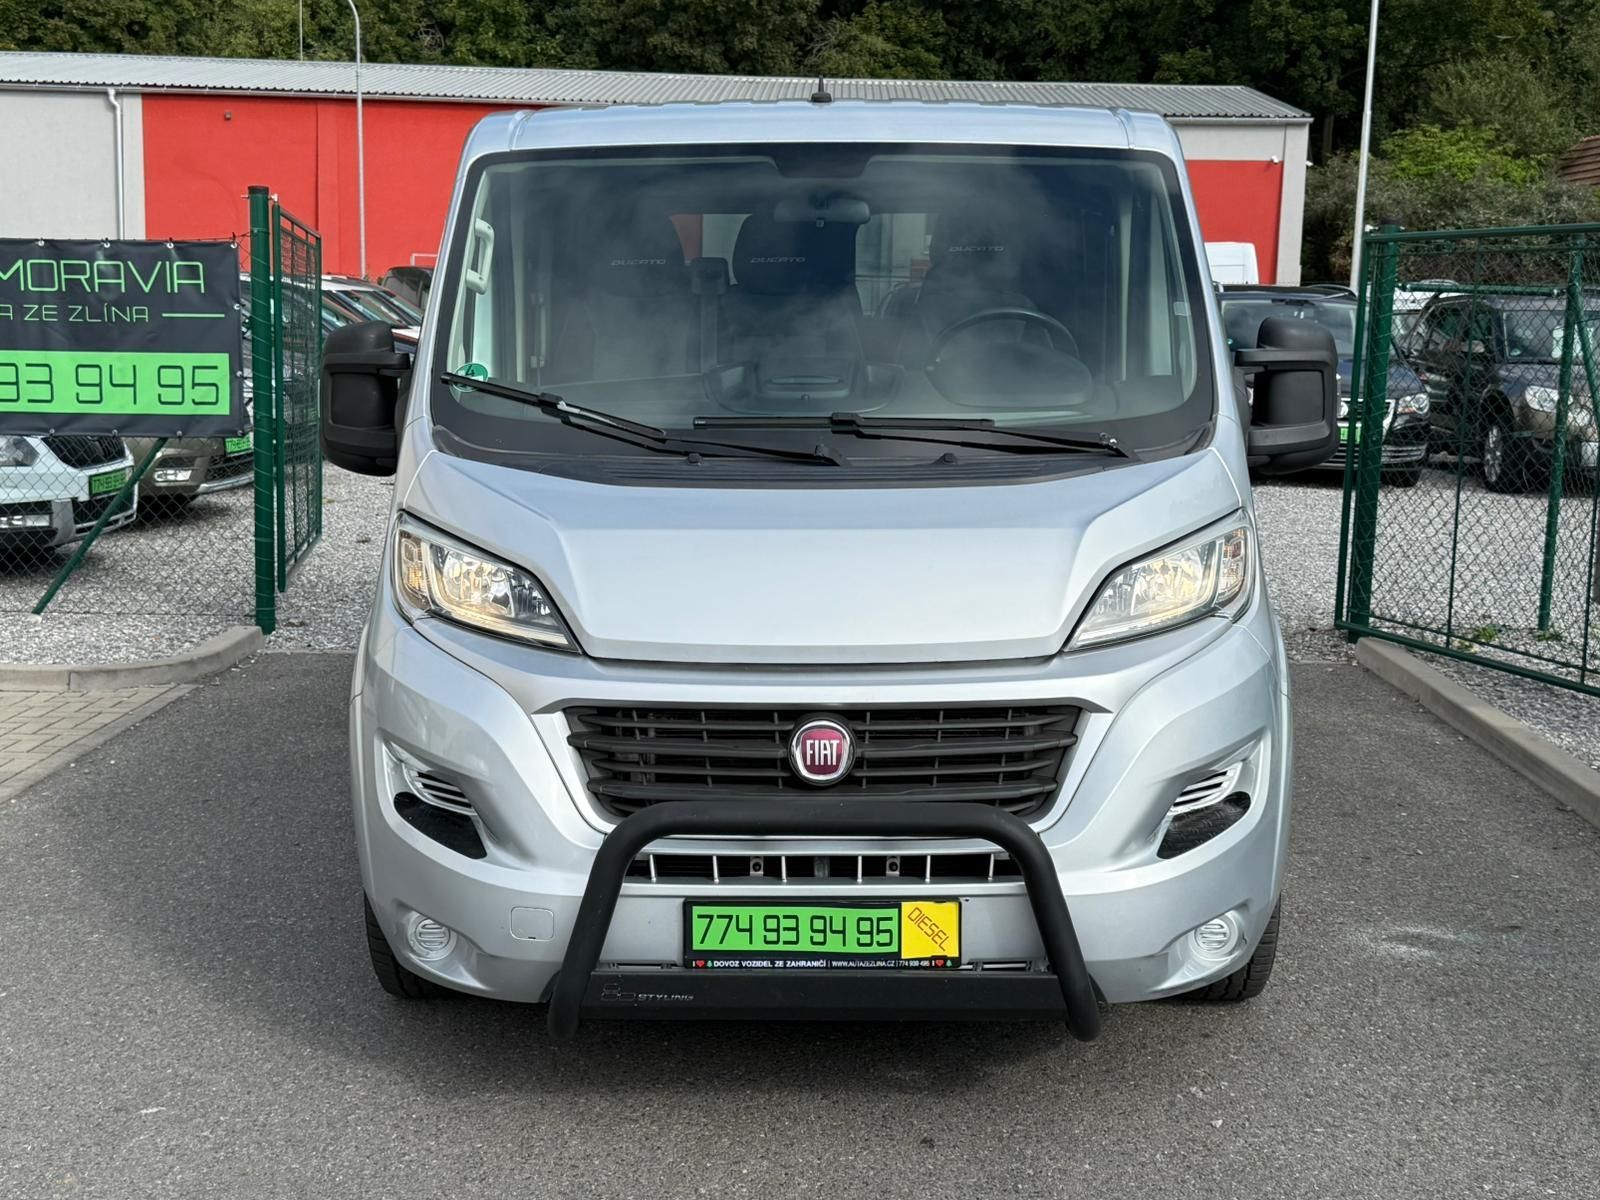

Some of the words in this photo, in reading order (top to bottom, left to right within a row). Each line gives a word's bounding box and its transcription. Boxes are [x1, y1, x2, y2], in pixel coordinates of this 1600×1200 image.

[0, 258, 205, 293] MORAVIA
[23, 304, 58, 321] ZE
[67, 302, 149, 323] ZLÍNA
[0, 362, 54, 403] 93
[75, 364, 137, 405] 94
[157, 365, 219, 406] 95
[806, 739, 840, 766] FIAT
[697, 914, 753, 945] 774
[763, 914, 800, 945] 93
[810, 915, 847, 947] 94
[856, 916, 893, 948] 95
[907, 906, 948, 952] DIESEL
[713, 960, 739, 968] DOVOZ
[741, 960, 772, 968] VOZIDEL
[774, 960, 784, 968] ZE
[786, 958, 827, 968] ZAHRANIČÍ
